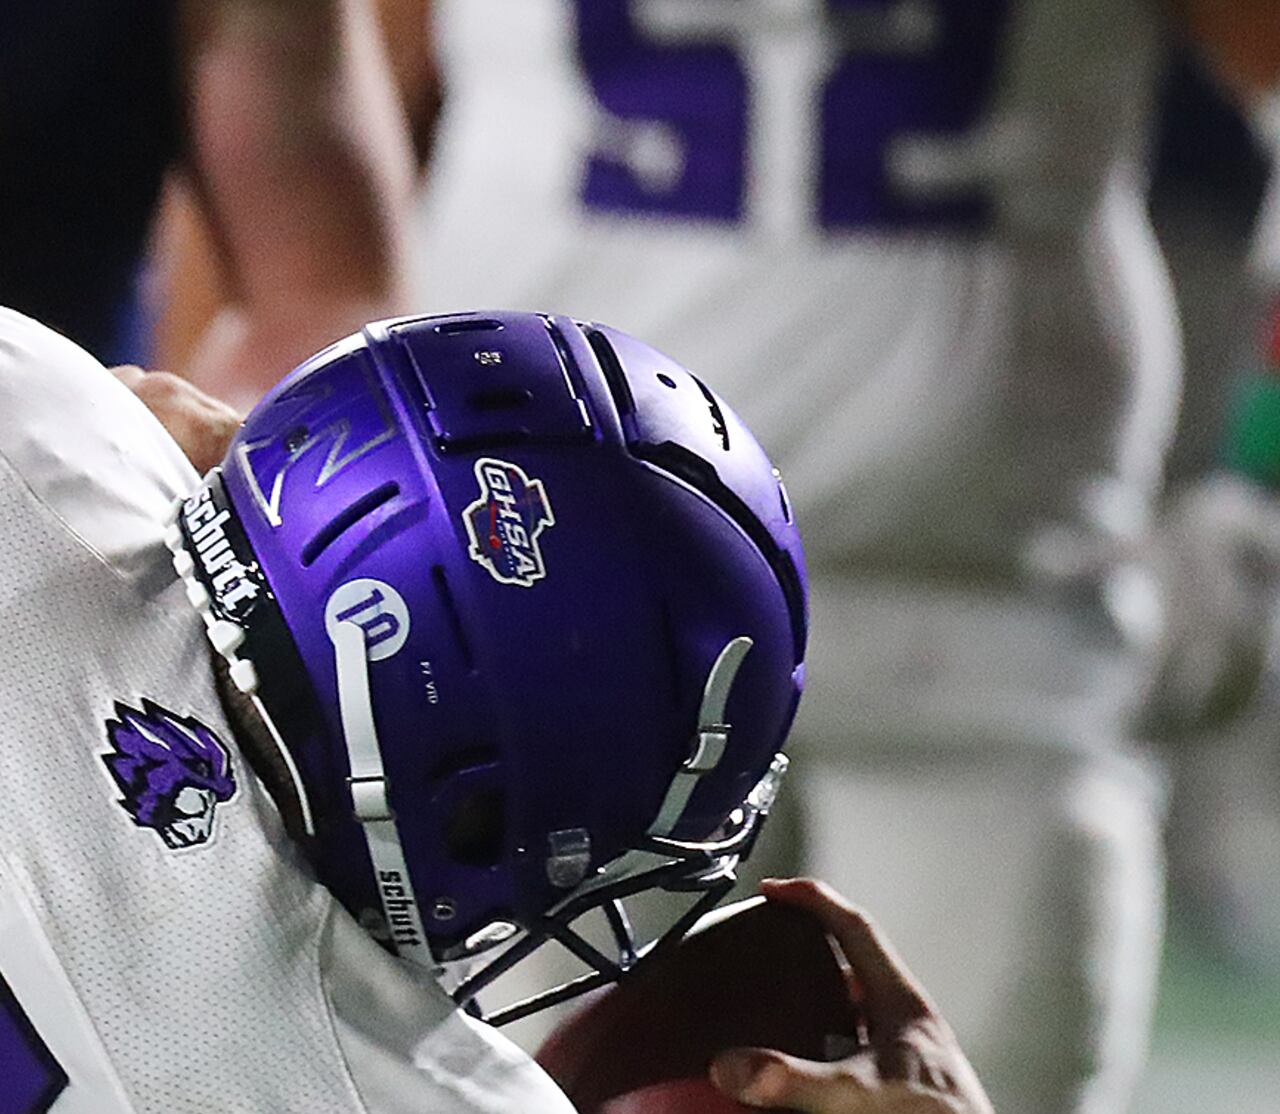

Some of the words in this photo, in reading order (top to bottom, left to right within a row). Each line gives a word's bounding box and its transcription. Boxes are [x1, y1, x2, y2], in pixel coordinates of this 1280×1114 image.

[570, 0, 1012, 236] 52
[183, 486, 261, 612] schutt
[484, 466, 537, 576] GHSA
[379, 870, 421, 947] schutt
